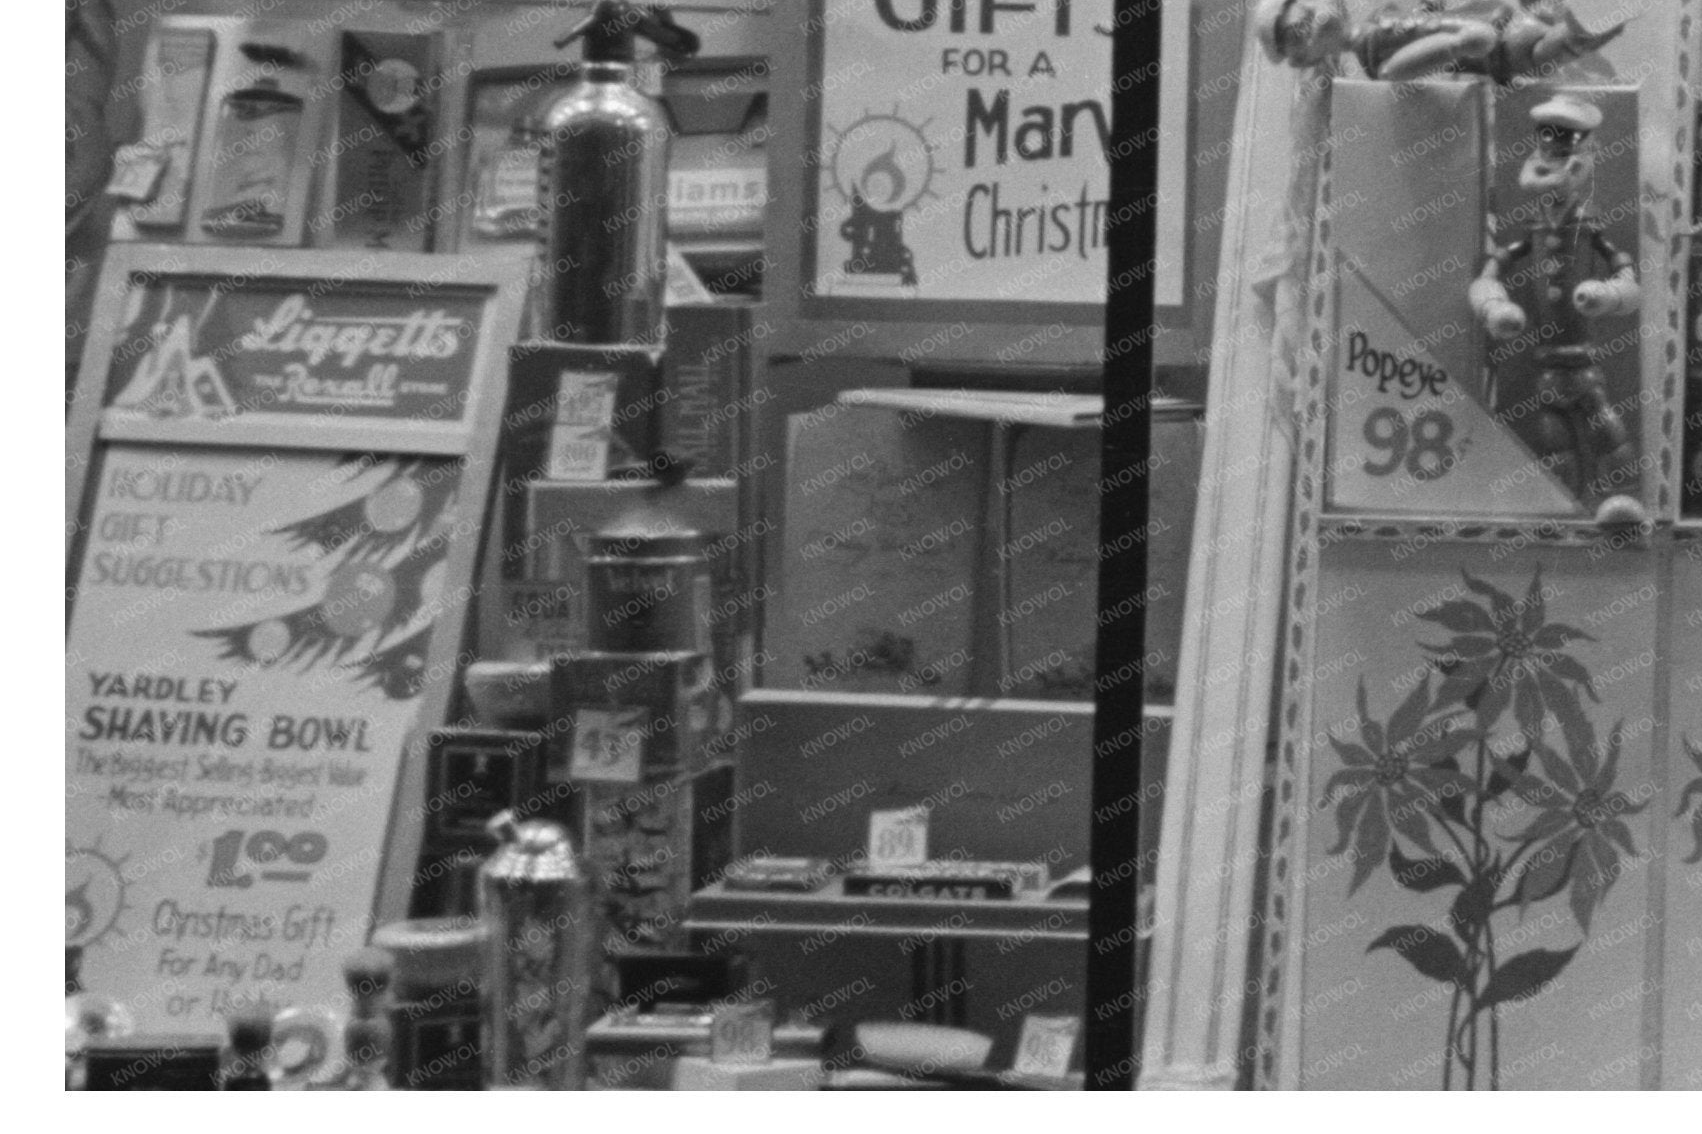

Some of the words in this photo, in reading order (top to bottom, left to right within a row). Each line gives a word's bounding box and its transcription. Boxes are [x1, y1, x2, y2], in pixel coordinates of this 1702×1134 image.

[941, 48, 1011, 76] FOR
[1028, 52, 1056, 78] A
[1345, 330, 1448, 399] Popeye
[279, 364, 400, 407] Rexall
[107, 468, 263, 505] HOLIDAY
[100, 512, 171, 544] GIFT
[88, 552, 311, 595] SUGGESTIONS
[87, 671, 238, 703] YARDLEY
[78, 705, 248, 748] SHAVING
[267, 715, 373, 752] BOWL
[869, 882, 988, 900] COLGATE
[152, 898, 273, 942] Christmas
[282, 904, 338, 949] Gift
[158, 948, 195, 976] For
[203, 952, 247, 984] Any
[252, 953, 306, 981] Dad
[166, 993, 200, 1016] or
